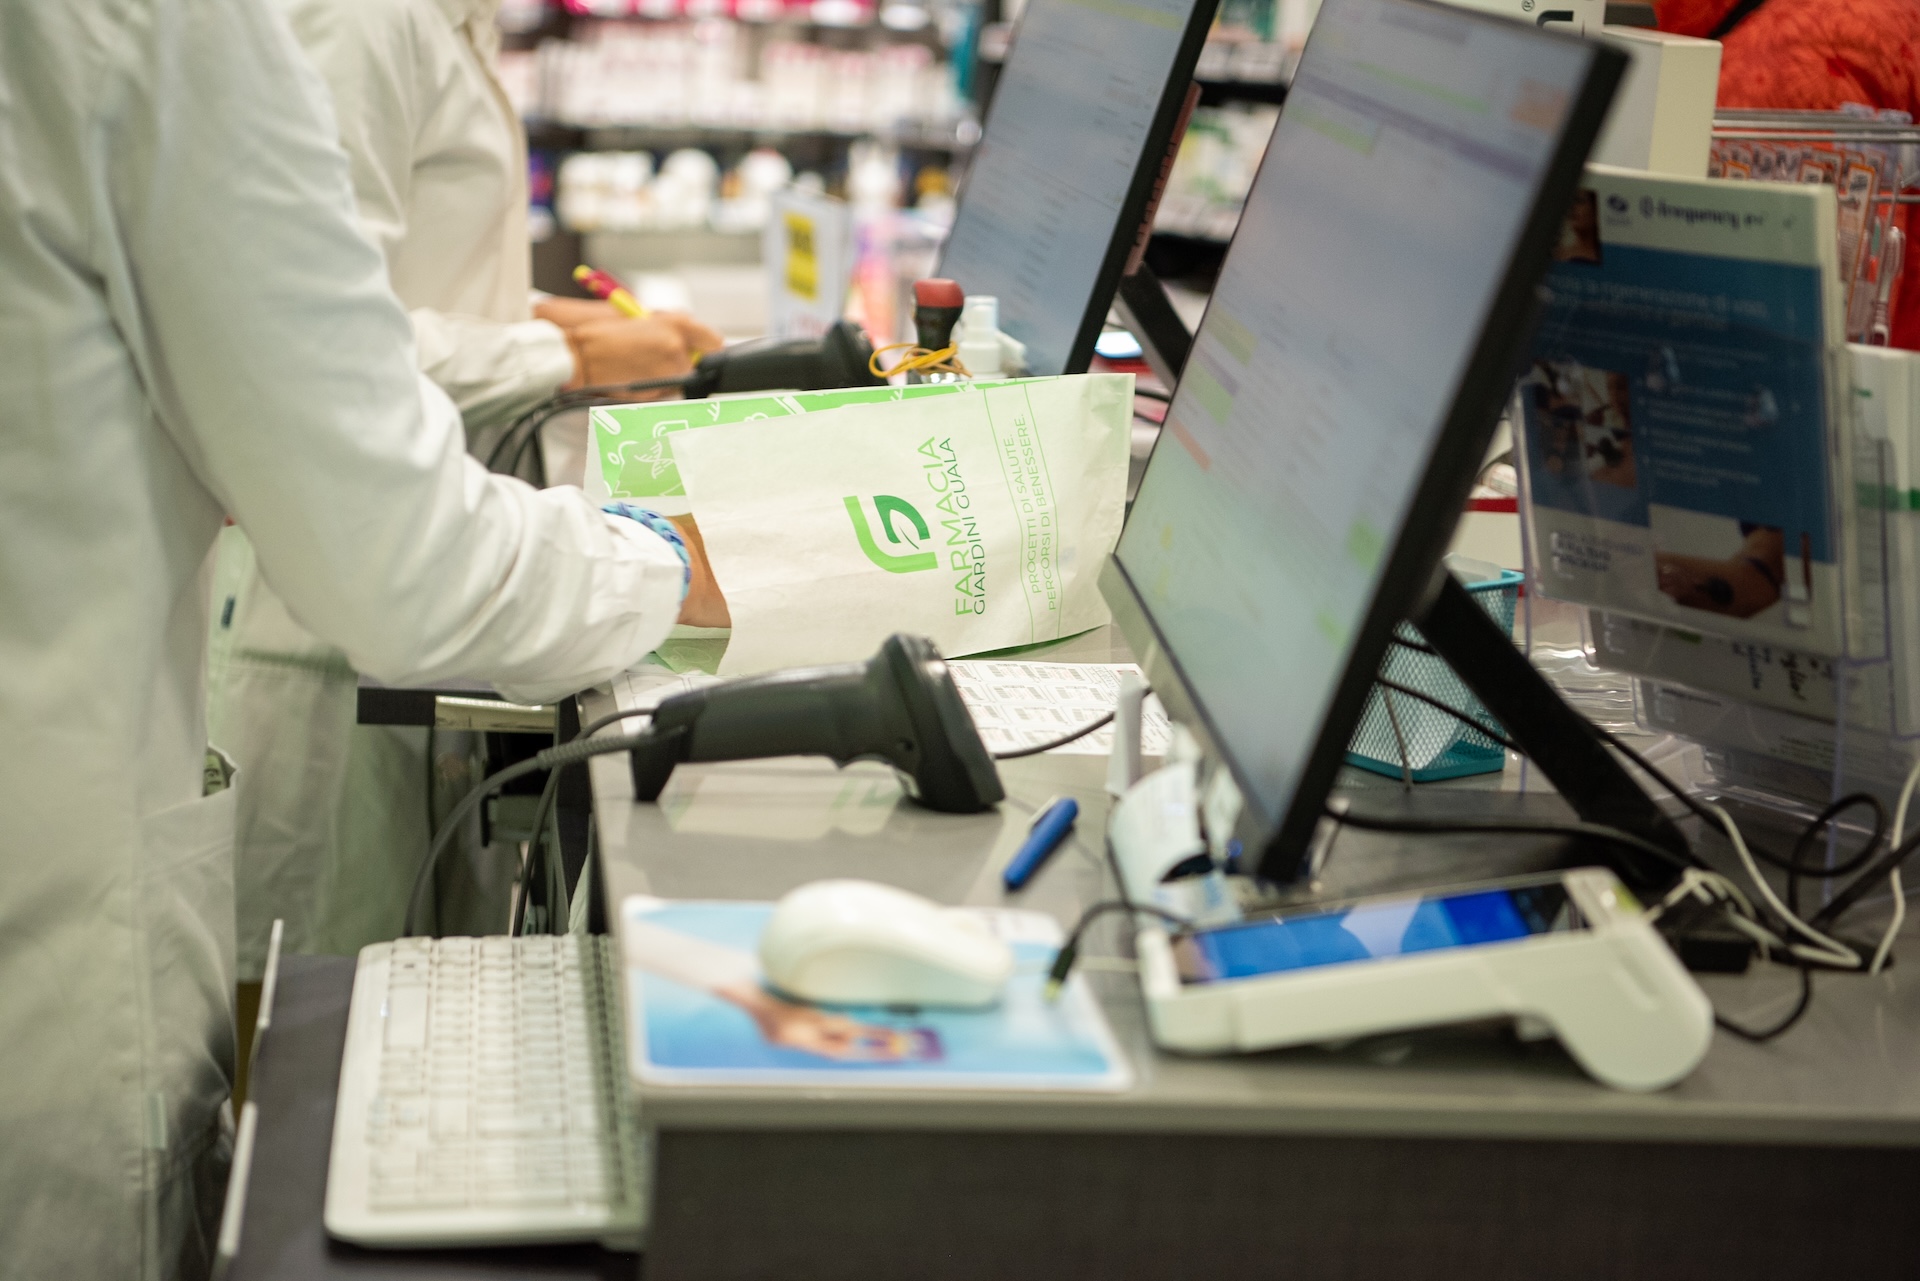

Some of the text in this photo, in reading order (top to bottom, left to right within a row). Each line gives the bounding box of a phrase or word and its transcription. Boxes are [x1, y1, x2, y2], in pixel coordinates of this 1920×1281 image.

[917, 436, 973, 615] FARMACIA
[939, 437, 985, 615] GIARDINI GUALA
[1003, 433, 1042, 594] PROGETTI DI SALUTE.
[1014, 413, 1057, 611] PERCORSI DI BENESSERE.
